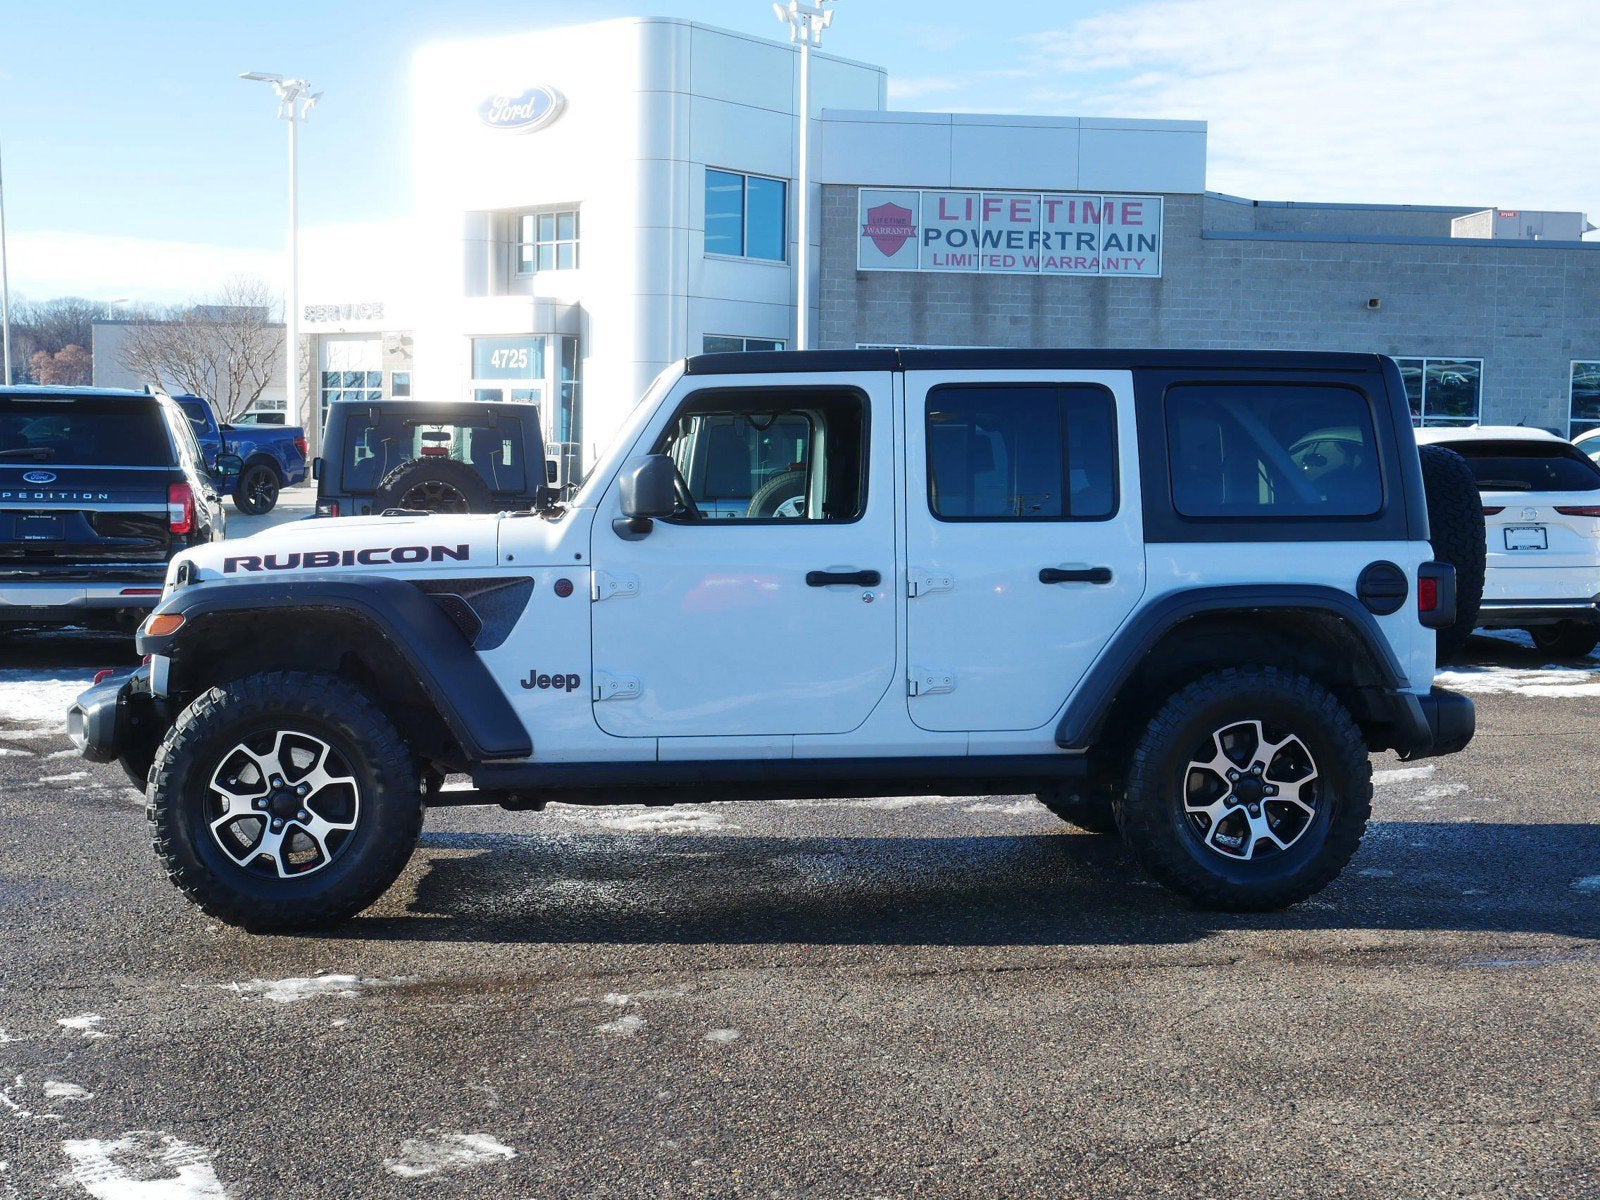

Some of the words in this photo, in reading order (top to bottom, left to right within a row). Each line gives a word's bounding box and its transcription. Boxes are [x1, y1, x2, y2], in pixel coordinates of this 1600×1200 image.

[488, 96, 536, 123] Ford
[873, 217, 906, 225] LIFETIME
[939, 197, 1143, 225] LIFETIME
[867, 227, 912, 235] WARRANTY
[924, 228, 1156, 252] POWERTRAIN
[933, 253, 1015, 268] LIMITED
[1023, 255, 1146, 270] WARRANTY
[304, 303, 384, 322] SERVICE
[491, 349, 528, 368] 4725
[223, 544, 470, 573] RUBICON
[521, 669, 581, 693] Jeep
